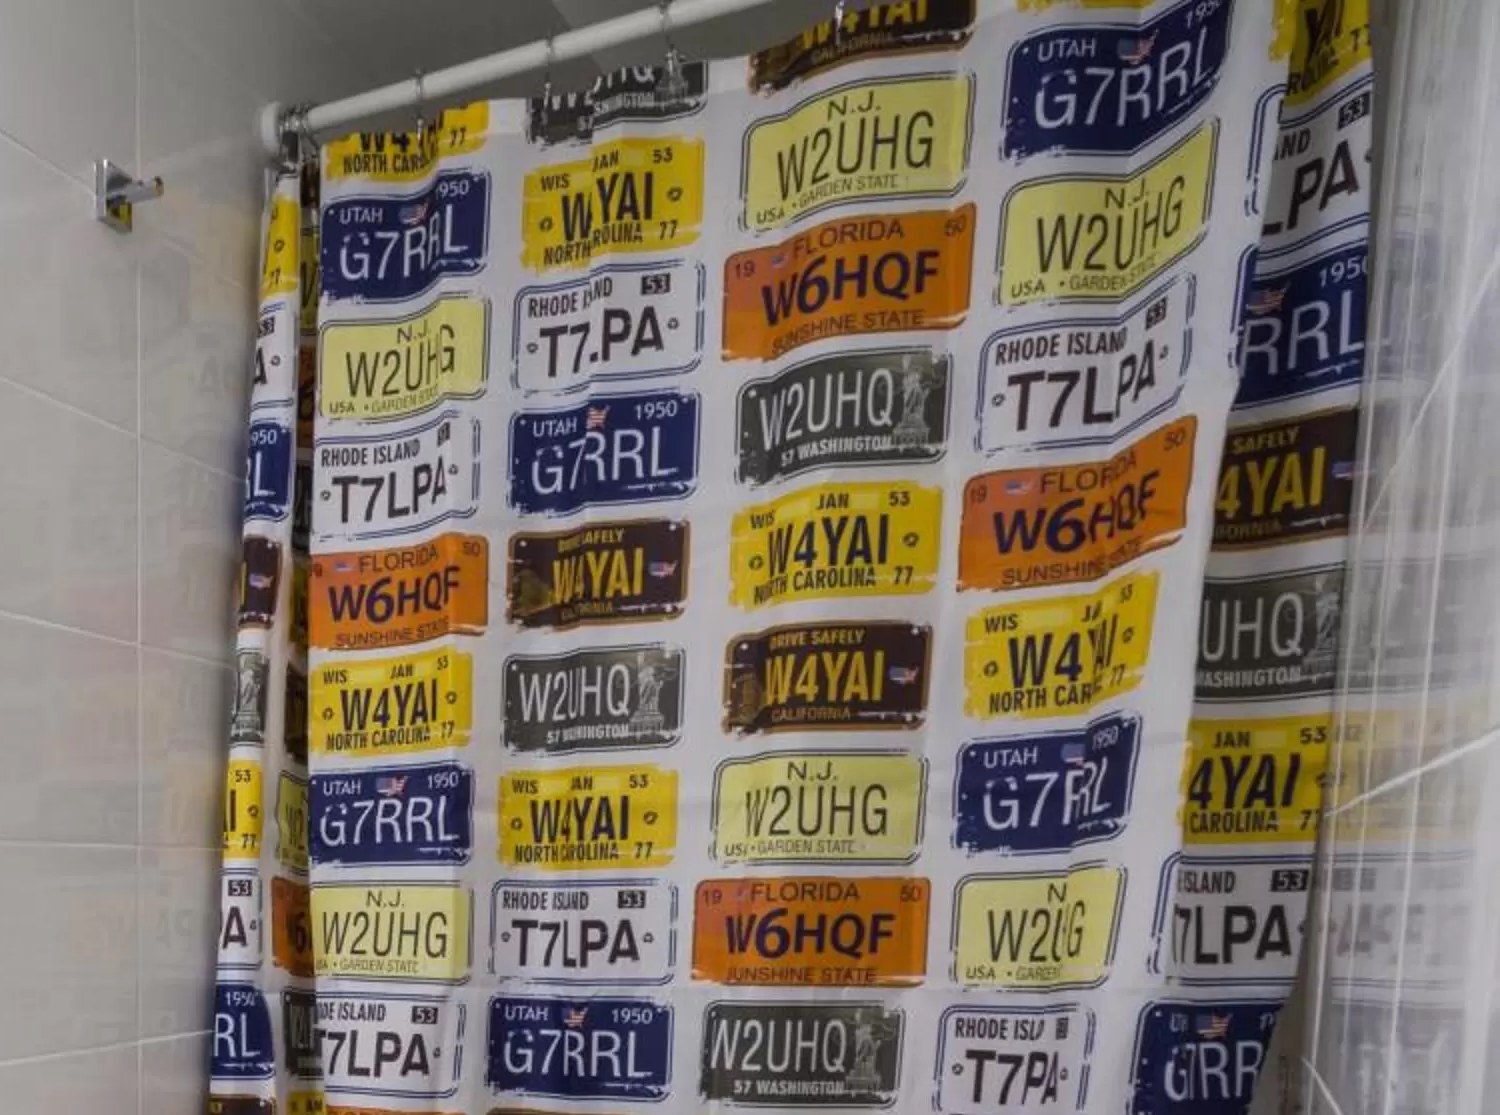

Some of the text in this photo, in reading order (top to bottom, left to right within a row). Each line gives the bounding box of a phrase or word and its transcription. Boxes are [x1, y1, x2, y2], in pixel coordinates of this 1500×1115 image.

[1037, 37, 1098, 63] UTAH
[1034, 25, 1210, 130] G7RRL
[826, 90, 882, 121] N.J.
[539, 147, 674, 193] WIS JAN 53
[776, 110, 935, 202] W2UHG
[755, 173, 900, 226] USA GARDEN STATE
[338, 207, 383, 226] UTAH
[1036, 175, 1186, 275] W2UHG
[339, 202, 468, 282] G7RRL
[543, 220, 679, 267] NORTH 77
[792, 218, 906, 260] FLORIDA
[760, 248, 942, 327] W6HQF
[1011, 280, 1046, 300] USA
[526, 290, 579, 320] RHODE
[859, 309, 926, 330] STATE
[994, 335, 1061, 367] RHODE
[1007, 338, 1157, 433] T7LPA
[328, 402, 355, 414] USA
[531, 400, 679, 439] UTAH 1950
[759, 367, 895, 452] W2UHQ
[320, 438, 420, 468] RHODE ISLAND
[797, 435, 893, 463] WASHINGTON
[1232, 425, 1301, 456] SAFELY
[330, 456, 447, 525] T7LPA
[816, 491, 911, 510] JAN 53
[992, 469, 1162, 556] W6HQF
[357, 544, 439, 575] FLORIDA
[767, 513, 890, 579] W4YAI
[793, 565, 915, 592] CAROLINA 77
[327, 565, 463, 626] W6HQF
[334, 624, 415, 649] SUNSHINE
[810, 627, 866, 647] SAFELY
[983, 613, 1019, 634] WIS
[322, 663, 415, 686] WIS JAN
[765, 649, 886, 706] W4YAI
[339, 678, 438, 732] W4YAI
[518, 663, 631, 724] W2UHQ
[988, 687, 1048, 715] NORTH
[325, 720, 456, 752] NORTH CAROLINA 77
[1212, 726, 1327, 749] JAN 53
[786, 760, 839, 782] N.J.
[982, 746, 1039, 770] UTAH
[234, 769, 252, 784] 53
[322, 772, 460, 798] UTAH 1950
[512, 773, 649, 795] WIS JAN 53
[319, 795, 460, 848] G7RRL
[530, 794, 630, 844] W4YAI
[745, 783, 889, 839] W2UHG
[1188, 808, 1280, 835] CAROLINA
[240, 833, 258, 850] 77
[513, 840, 654, 865] NORTH 77
[816, 839, 856, 855] STATE
[364, 889, 406, 908] N.J.
[502, 890, 589, 911] RHODE ISLAND
[702, 880, 922, 906] 19 FLORIDA 50
[321, 911, 449, 960] W2UHG
[511, 918, 641, 970] T7LPA
[724, 907, 897, 960] W6HQF
[821, 967, 878, 983] STATE
[965, 966, 996, 982] USA
[337, 1001, 437, 1024] ISLAND 53
[503, 1004, 653, 1026] UTAH 1950
[954, 1017, 1009, 1041] RHODE
[502, 1028, 654, 1079] G7RRL
[755, 1079, 845, 1097] WASHINGTON
